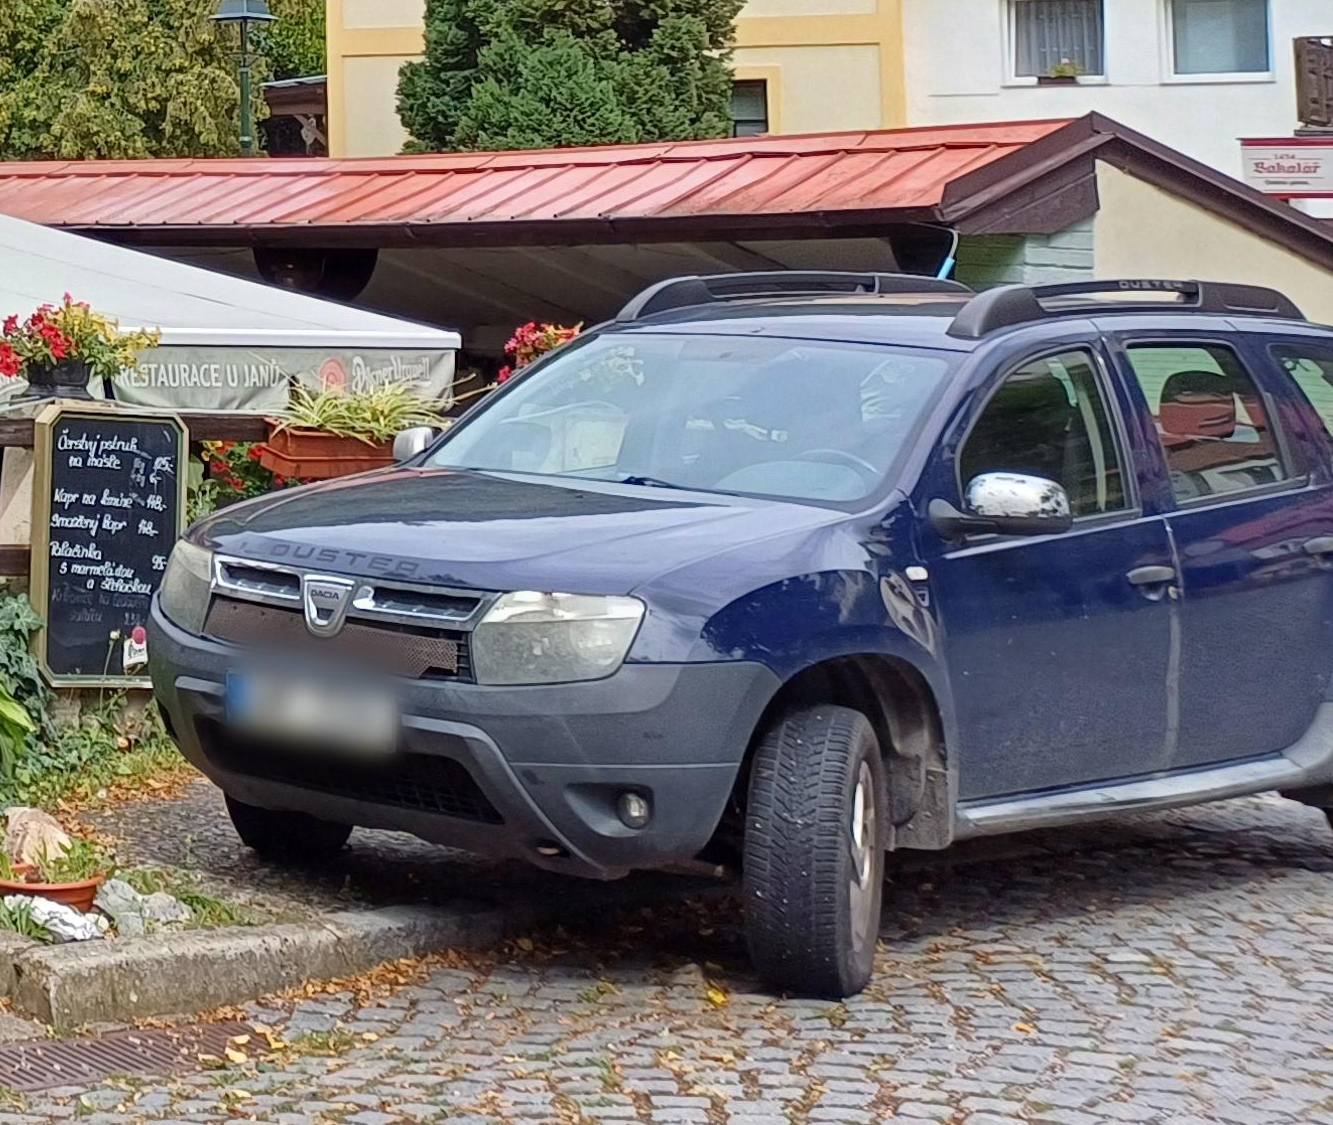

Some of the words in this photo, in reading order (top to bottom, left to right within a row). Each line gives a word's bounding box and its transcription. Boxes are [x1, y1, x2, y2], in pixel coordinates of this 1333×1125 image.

[118, 363, 222, 387] RESTAURACE
[226, 364, 239, 387] U
[243, 358, 281, 387] JANŮ
[69, 456, 82, 467] na
[54, 488, 79, 509] Kapr
[82, 493, 96, 505] na
[269, 543, 420, 575] DUSTER
[311, 589, 340, 600] DACIA
